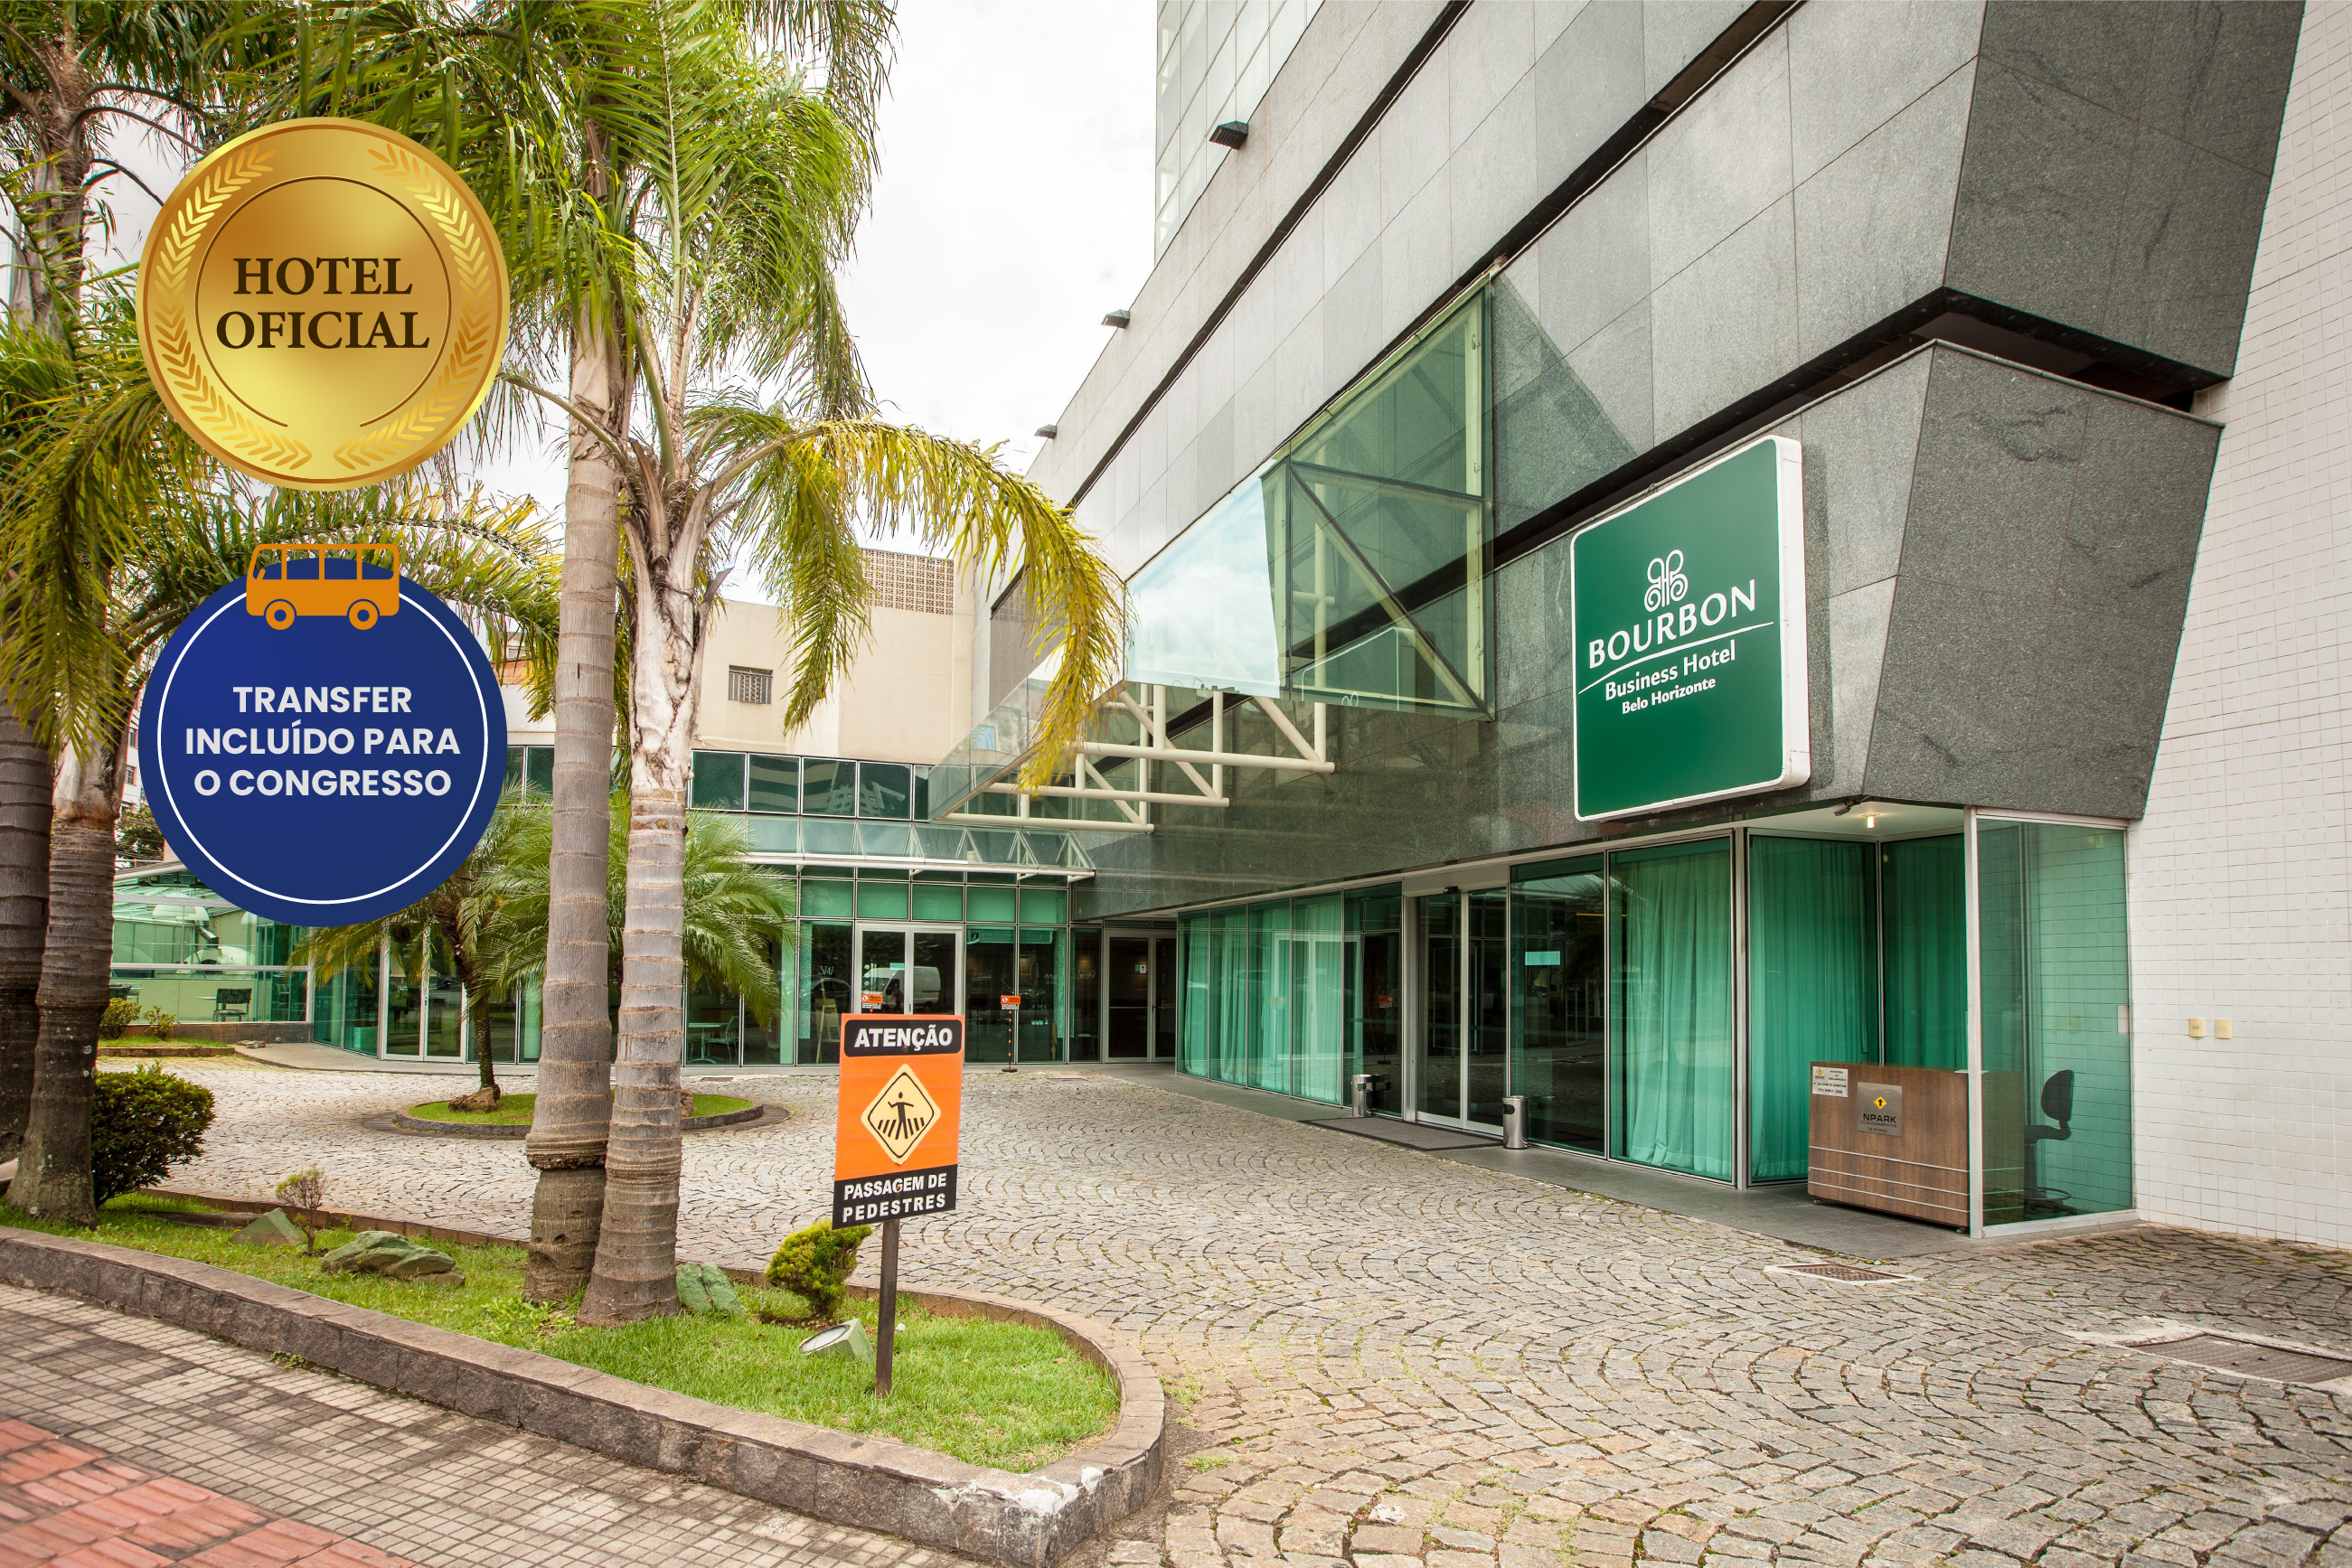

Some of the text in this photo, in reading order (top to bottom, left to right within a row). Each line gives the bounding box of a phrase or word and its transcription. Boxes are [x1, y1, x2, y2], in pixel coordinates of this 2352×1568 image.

[1588, 578, 1755, 669] BOURBON
[1604, 639, 1736, 700] Business Hotel
[1622, 677, 1717, 715] Belo Horizonte
[854, 1024, 953, 1051] ATENÇÃO
[1863, 1113, 1896, 1124] NPARK
[844, 1173, 947, 1200] PASSAGEM DE
[842, 1193, 946, 1223] PEDESTRES
